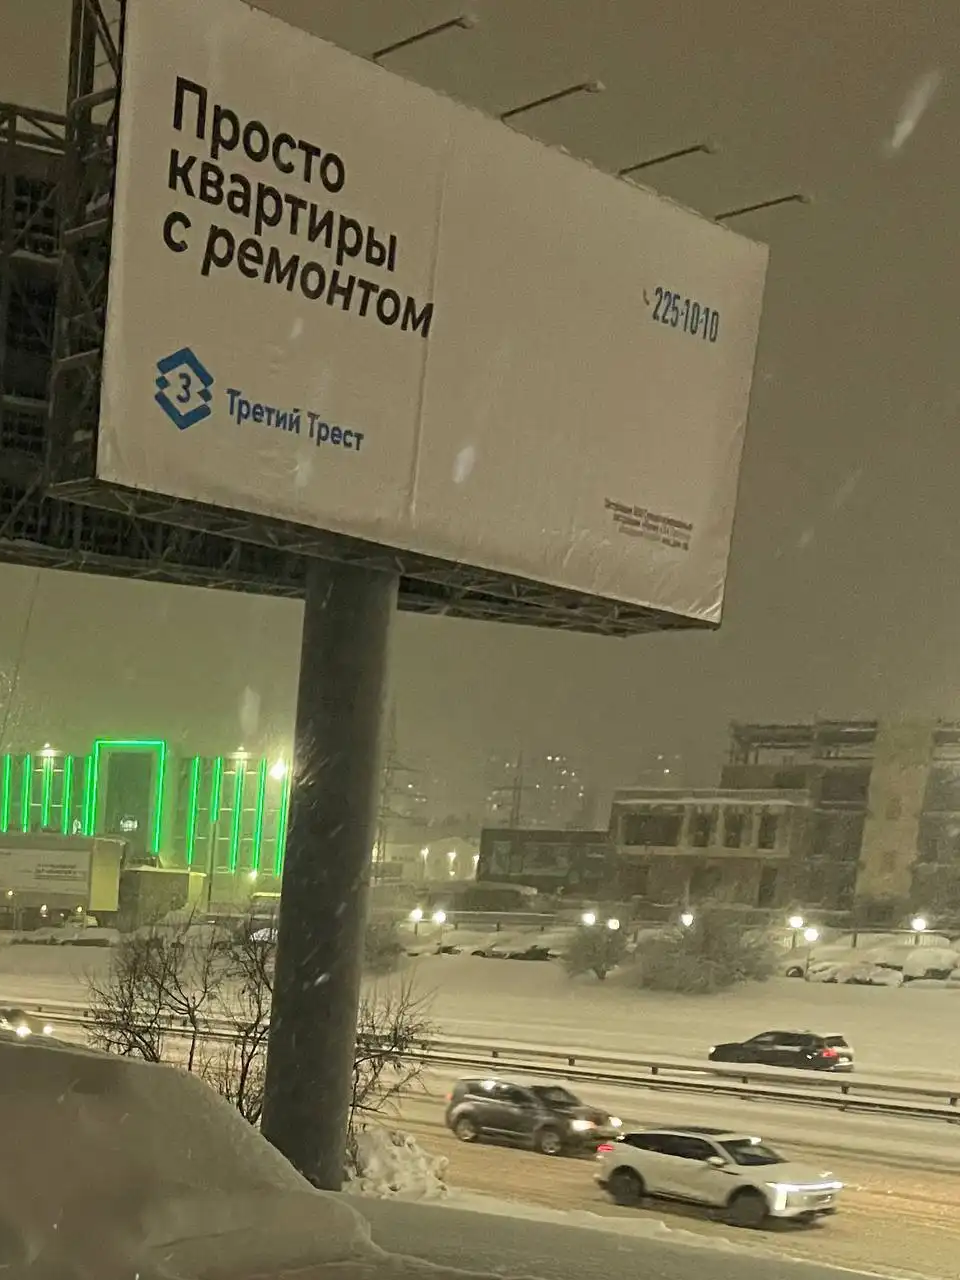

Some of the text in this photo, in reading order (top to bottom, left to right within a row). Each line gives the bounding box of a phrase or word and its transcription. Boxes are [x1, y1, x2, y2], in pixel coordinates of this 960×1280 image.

[173, 75, 345, 193] Просто
[167, 148, 397, 272] квартиры
[162, 210, 434, 338] с ремонтом
[226, 387, 365, 451] Третий Трест
